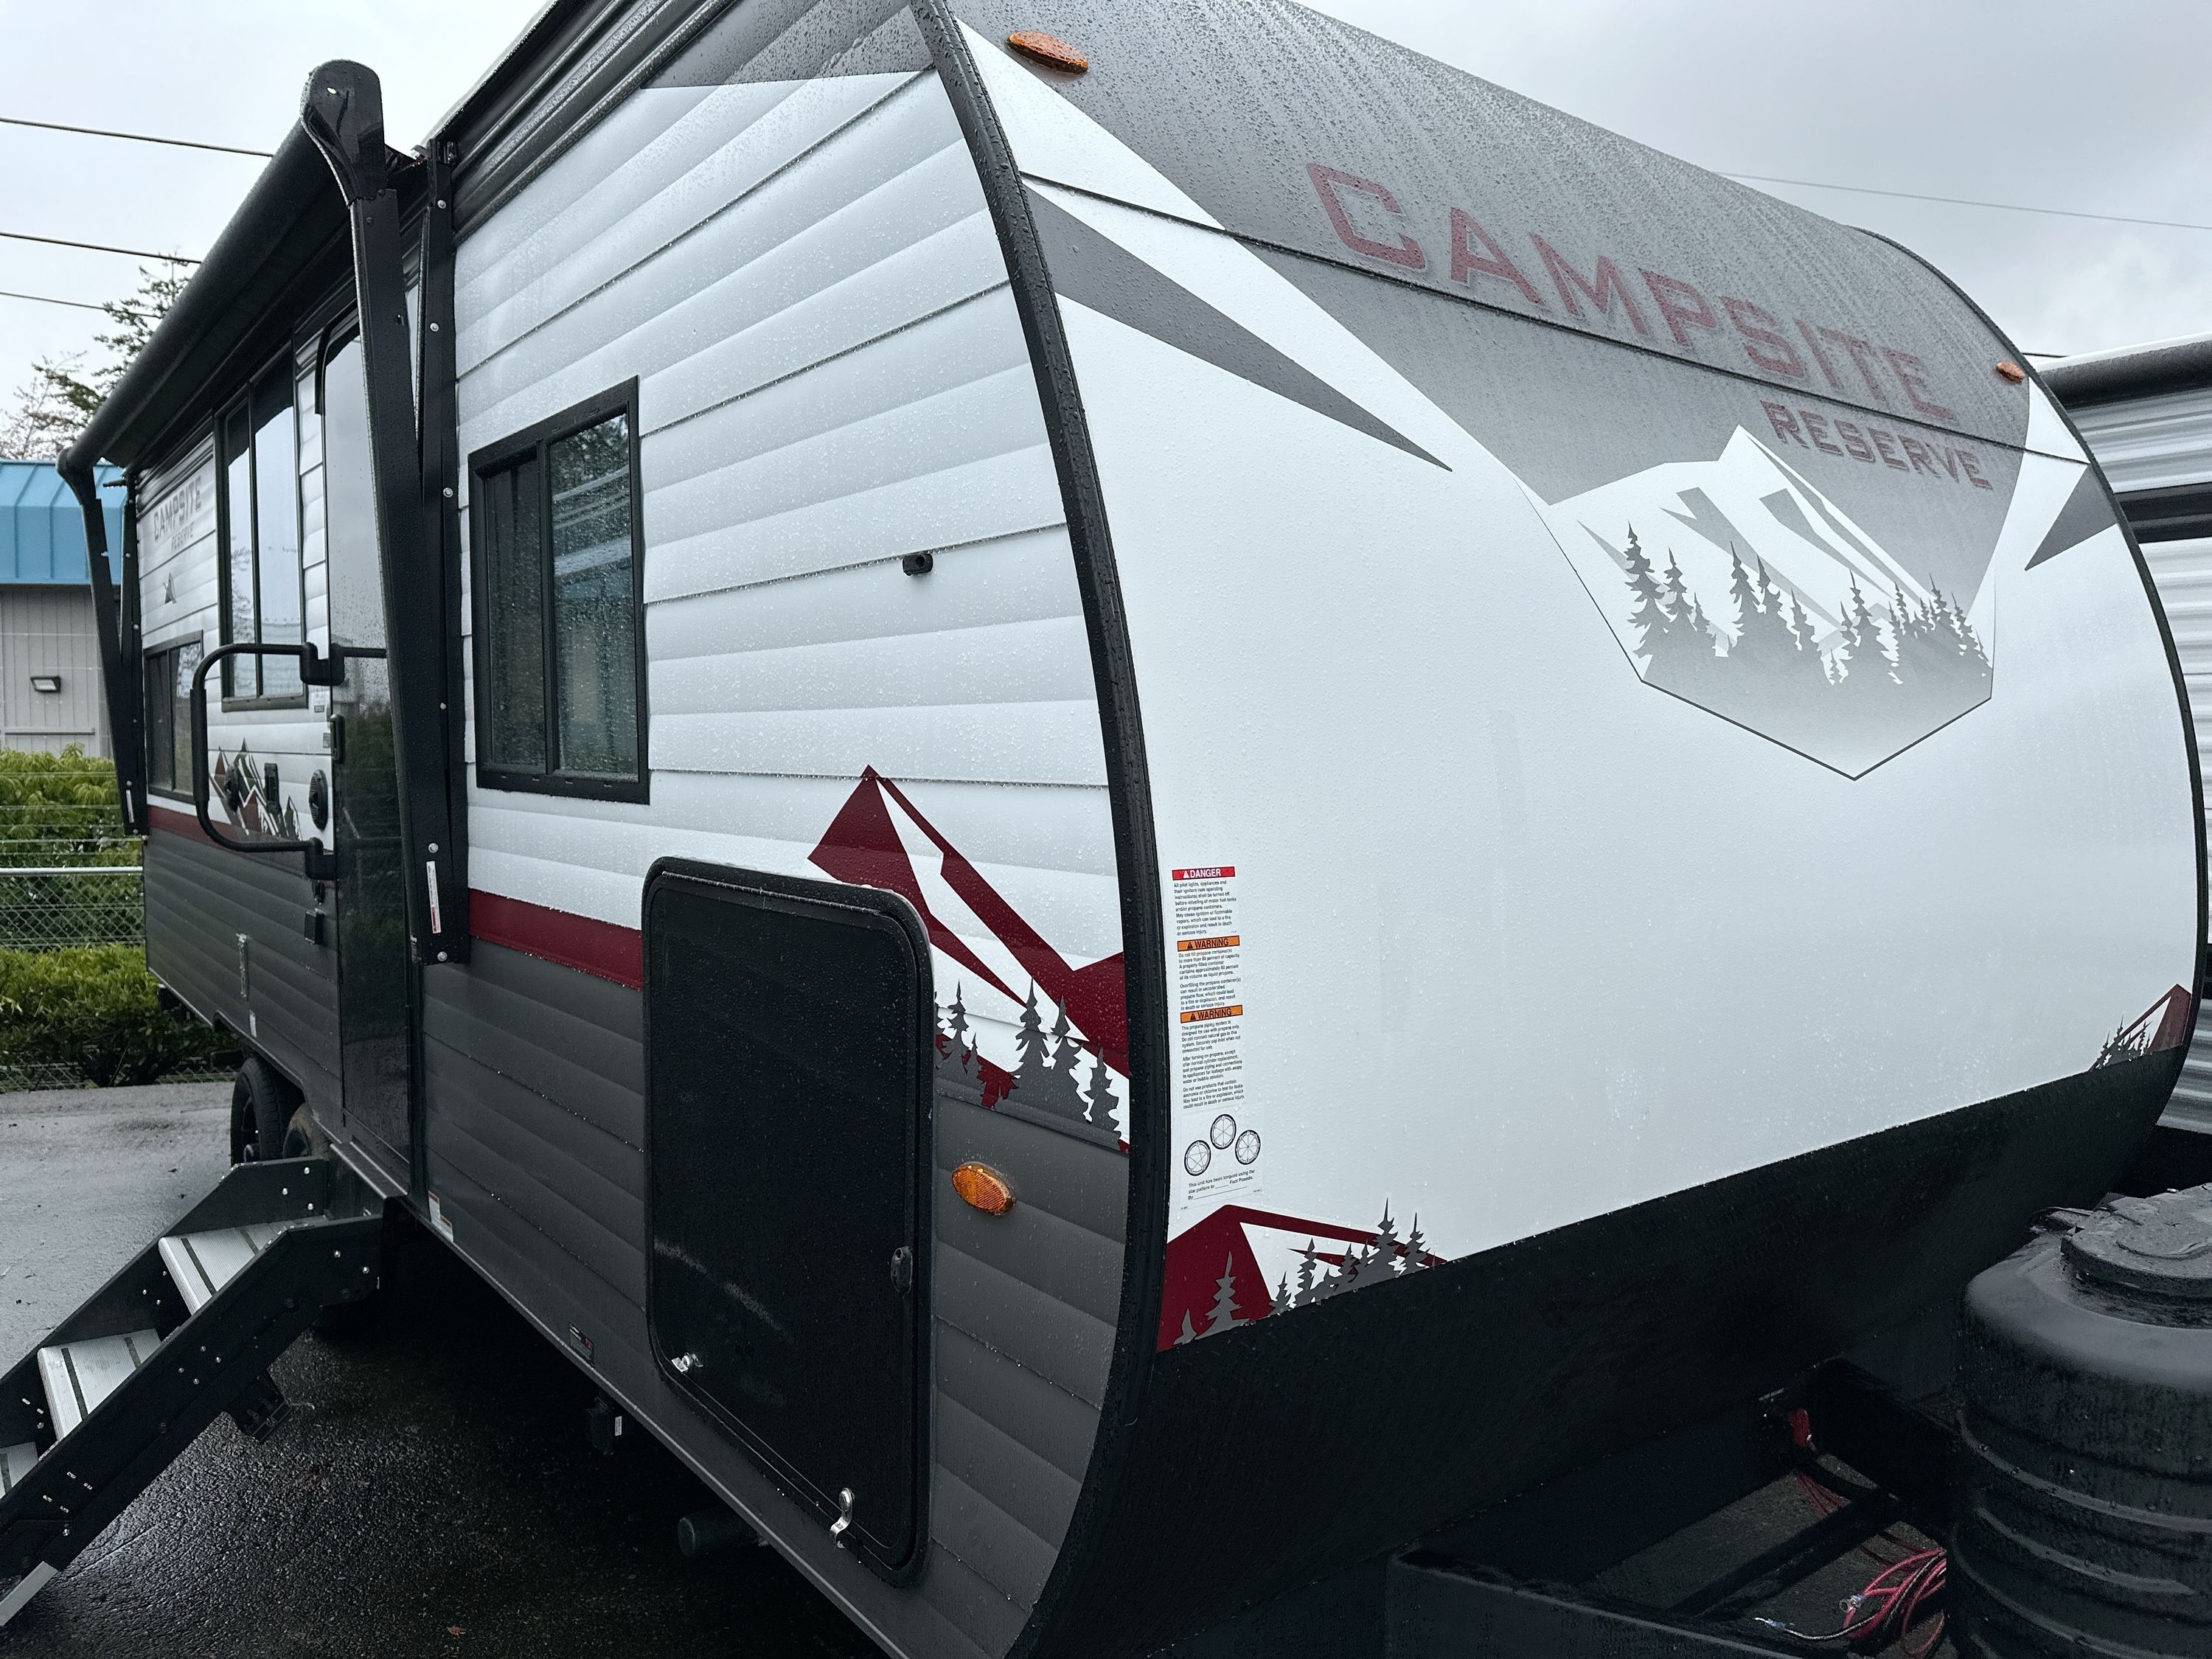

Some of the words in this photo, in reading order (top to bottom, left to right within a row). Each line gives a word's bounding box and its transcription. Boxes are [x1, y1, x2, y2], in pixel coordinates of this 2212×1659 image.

[1307, 163, 1955, 420] CAMPSITE
[1760, 400, 1994, 491] RESERVE
[154, 475, 201, 542] CAMPSITE
[1190, 869, 1222, 878] DANGER
[1195, 938, 1228, 949] WARNING
[1197, 1008, 1232, 1020] WARNING
